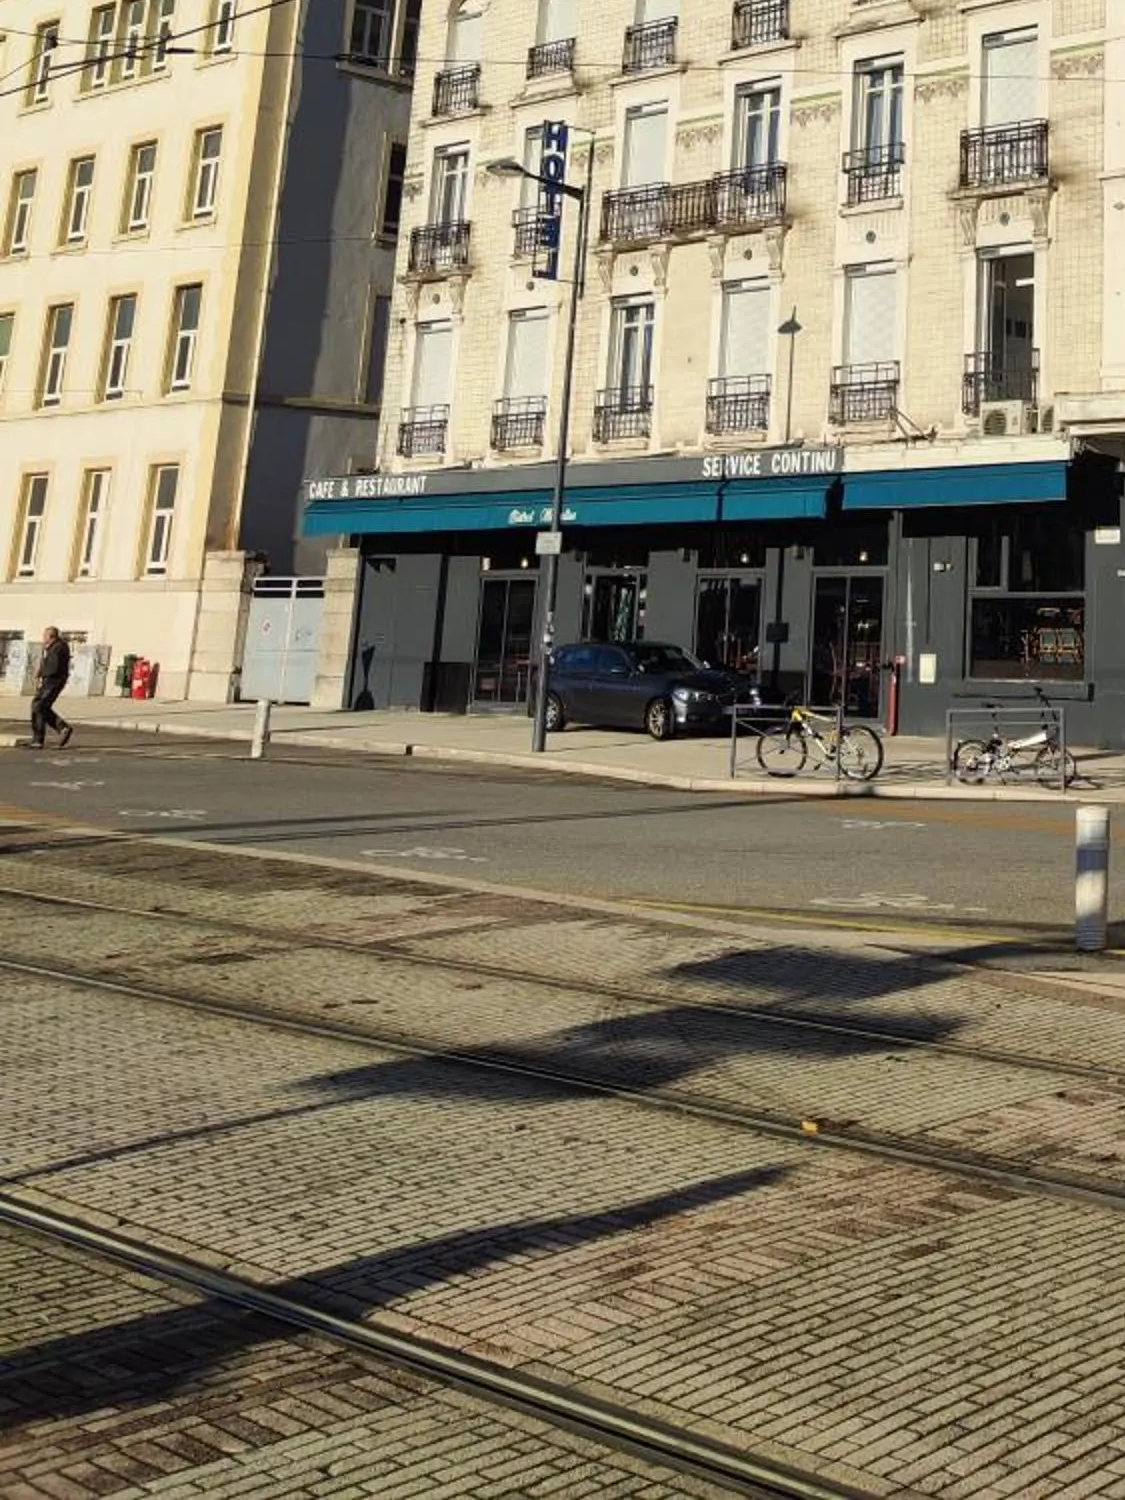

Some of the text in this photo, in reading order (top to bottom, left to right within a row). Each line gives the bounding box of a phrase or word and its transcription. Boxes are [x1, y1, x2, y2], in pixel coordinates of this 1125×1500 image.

[702, 450, 836, 478] SERVICE CONTINU
[355, 475, 427, 496] RESTAURANT
